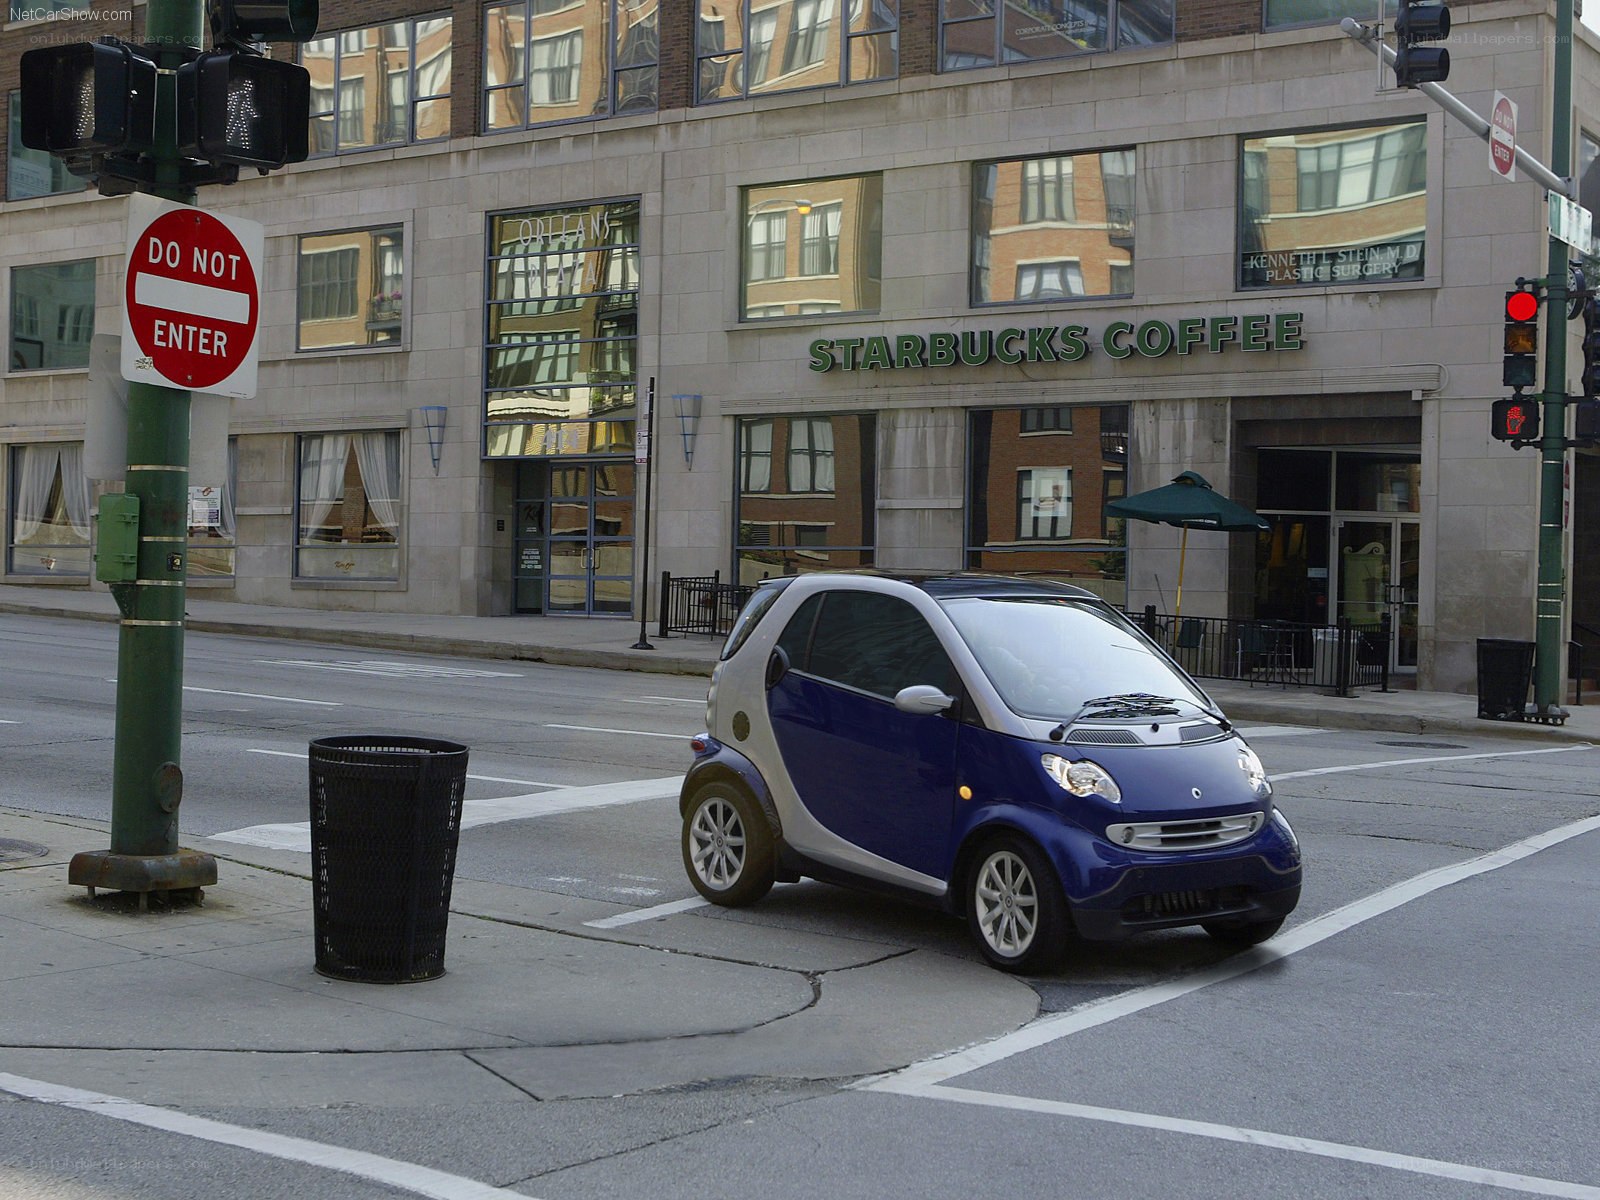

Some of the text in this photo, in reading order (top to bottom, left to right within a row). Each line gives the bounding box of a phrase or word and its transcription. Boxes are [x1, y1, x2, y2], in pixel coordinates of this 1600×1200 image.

[1495, 144, 1510, 163] ENTER
[519, 211, 610, 247] ORLEANS
[148, 236, 241, 281] DO NOT
[529, 258, 597, 290] PLAZA
[1250, 251, 1316, 269] KENNETH
[1266, 262, 1402, 281] PLASTIC SURGERY
[154, 319, 228, 358] ENTER
[808, 312, 1304, 374] STARBUCKS COFFEE
